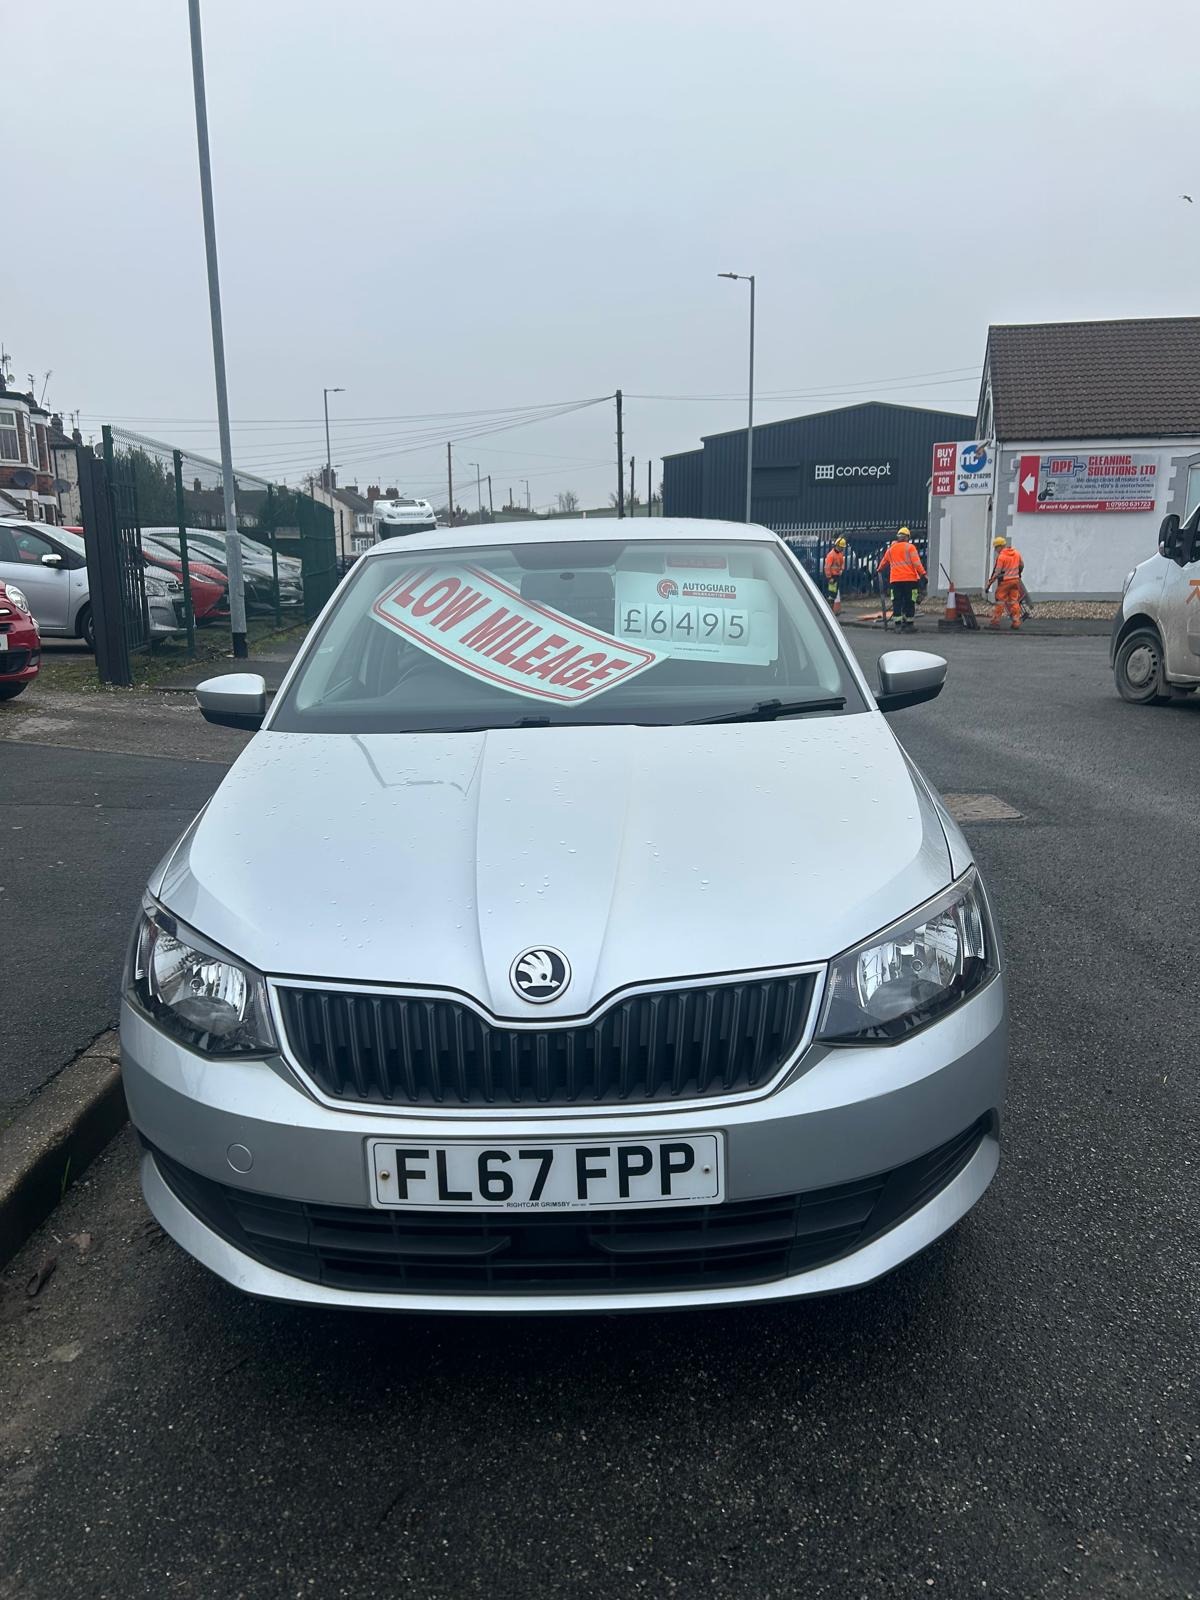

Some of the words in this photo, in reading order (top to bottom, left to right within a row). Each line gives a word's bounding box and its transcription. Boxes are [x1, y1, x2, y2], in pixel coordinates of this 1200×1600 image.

[937, 448, 954, 458] BUY
[939, 458, 950, 467] IT!
[1088, 456, 1132, 466] CLEANING
[836, 462, 891, 479] concept
[1051, 461, 1073, 473] DPF
[1087, 466, 1137, 476] SOLUTIONS
[1140, 465, 1156, 476] LTD
[1086, 477, 1099, 485] deep
[682, 582, 737, 593] AUTOGUARD
[392, 566, 492, 633] LOW
[458, 606, 633, 692] MILEAGE
[624, 609, 744, 639] £6495
[395, 1148, 554, 1202] FL67
[575, 1142, 696, 1200] FPP
